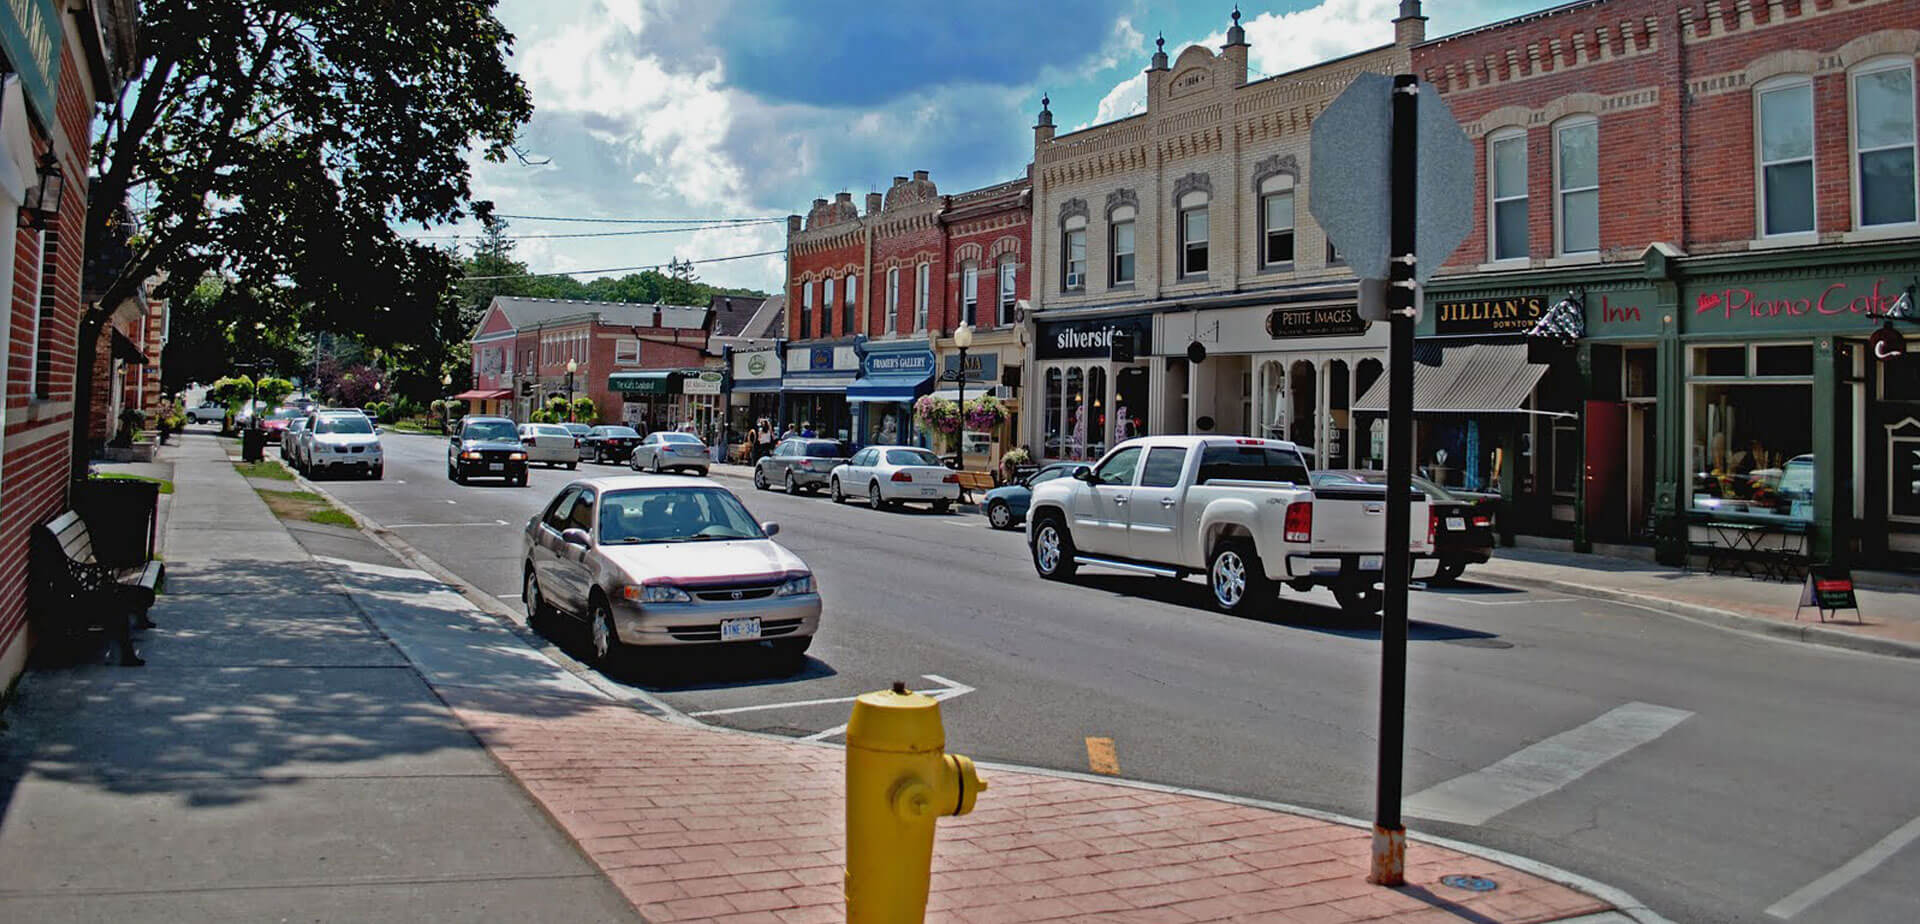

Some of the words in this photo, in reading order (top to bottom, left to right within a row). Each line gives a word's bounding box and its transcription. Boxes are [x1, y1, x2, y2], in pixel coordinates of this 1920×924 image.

[1440, 297, 1541, 322] JILLIAN'S
[1601, 294, 1641, 323] Inn
[1722, 287, 1812, 319] Piano
[1282, 311, 1312, 326] PETITE
[1314, 309, 1352, 324] IMAGES
[1493, 319, 1539, 329] DOWNTOW
[900, 357, 926, 368] GALLERY
